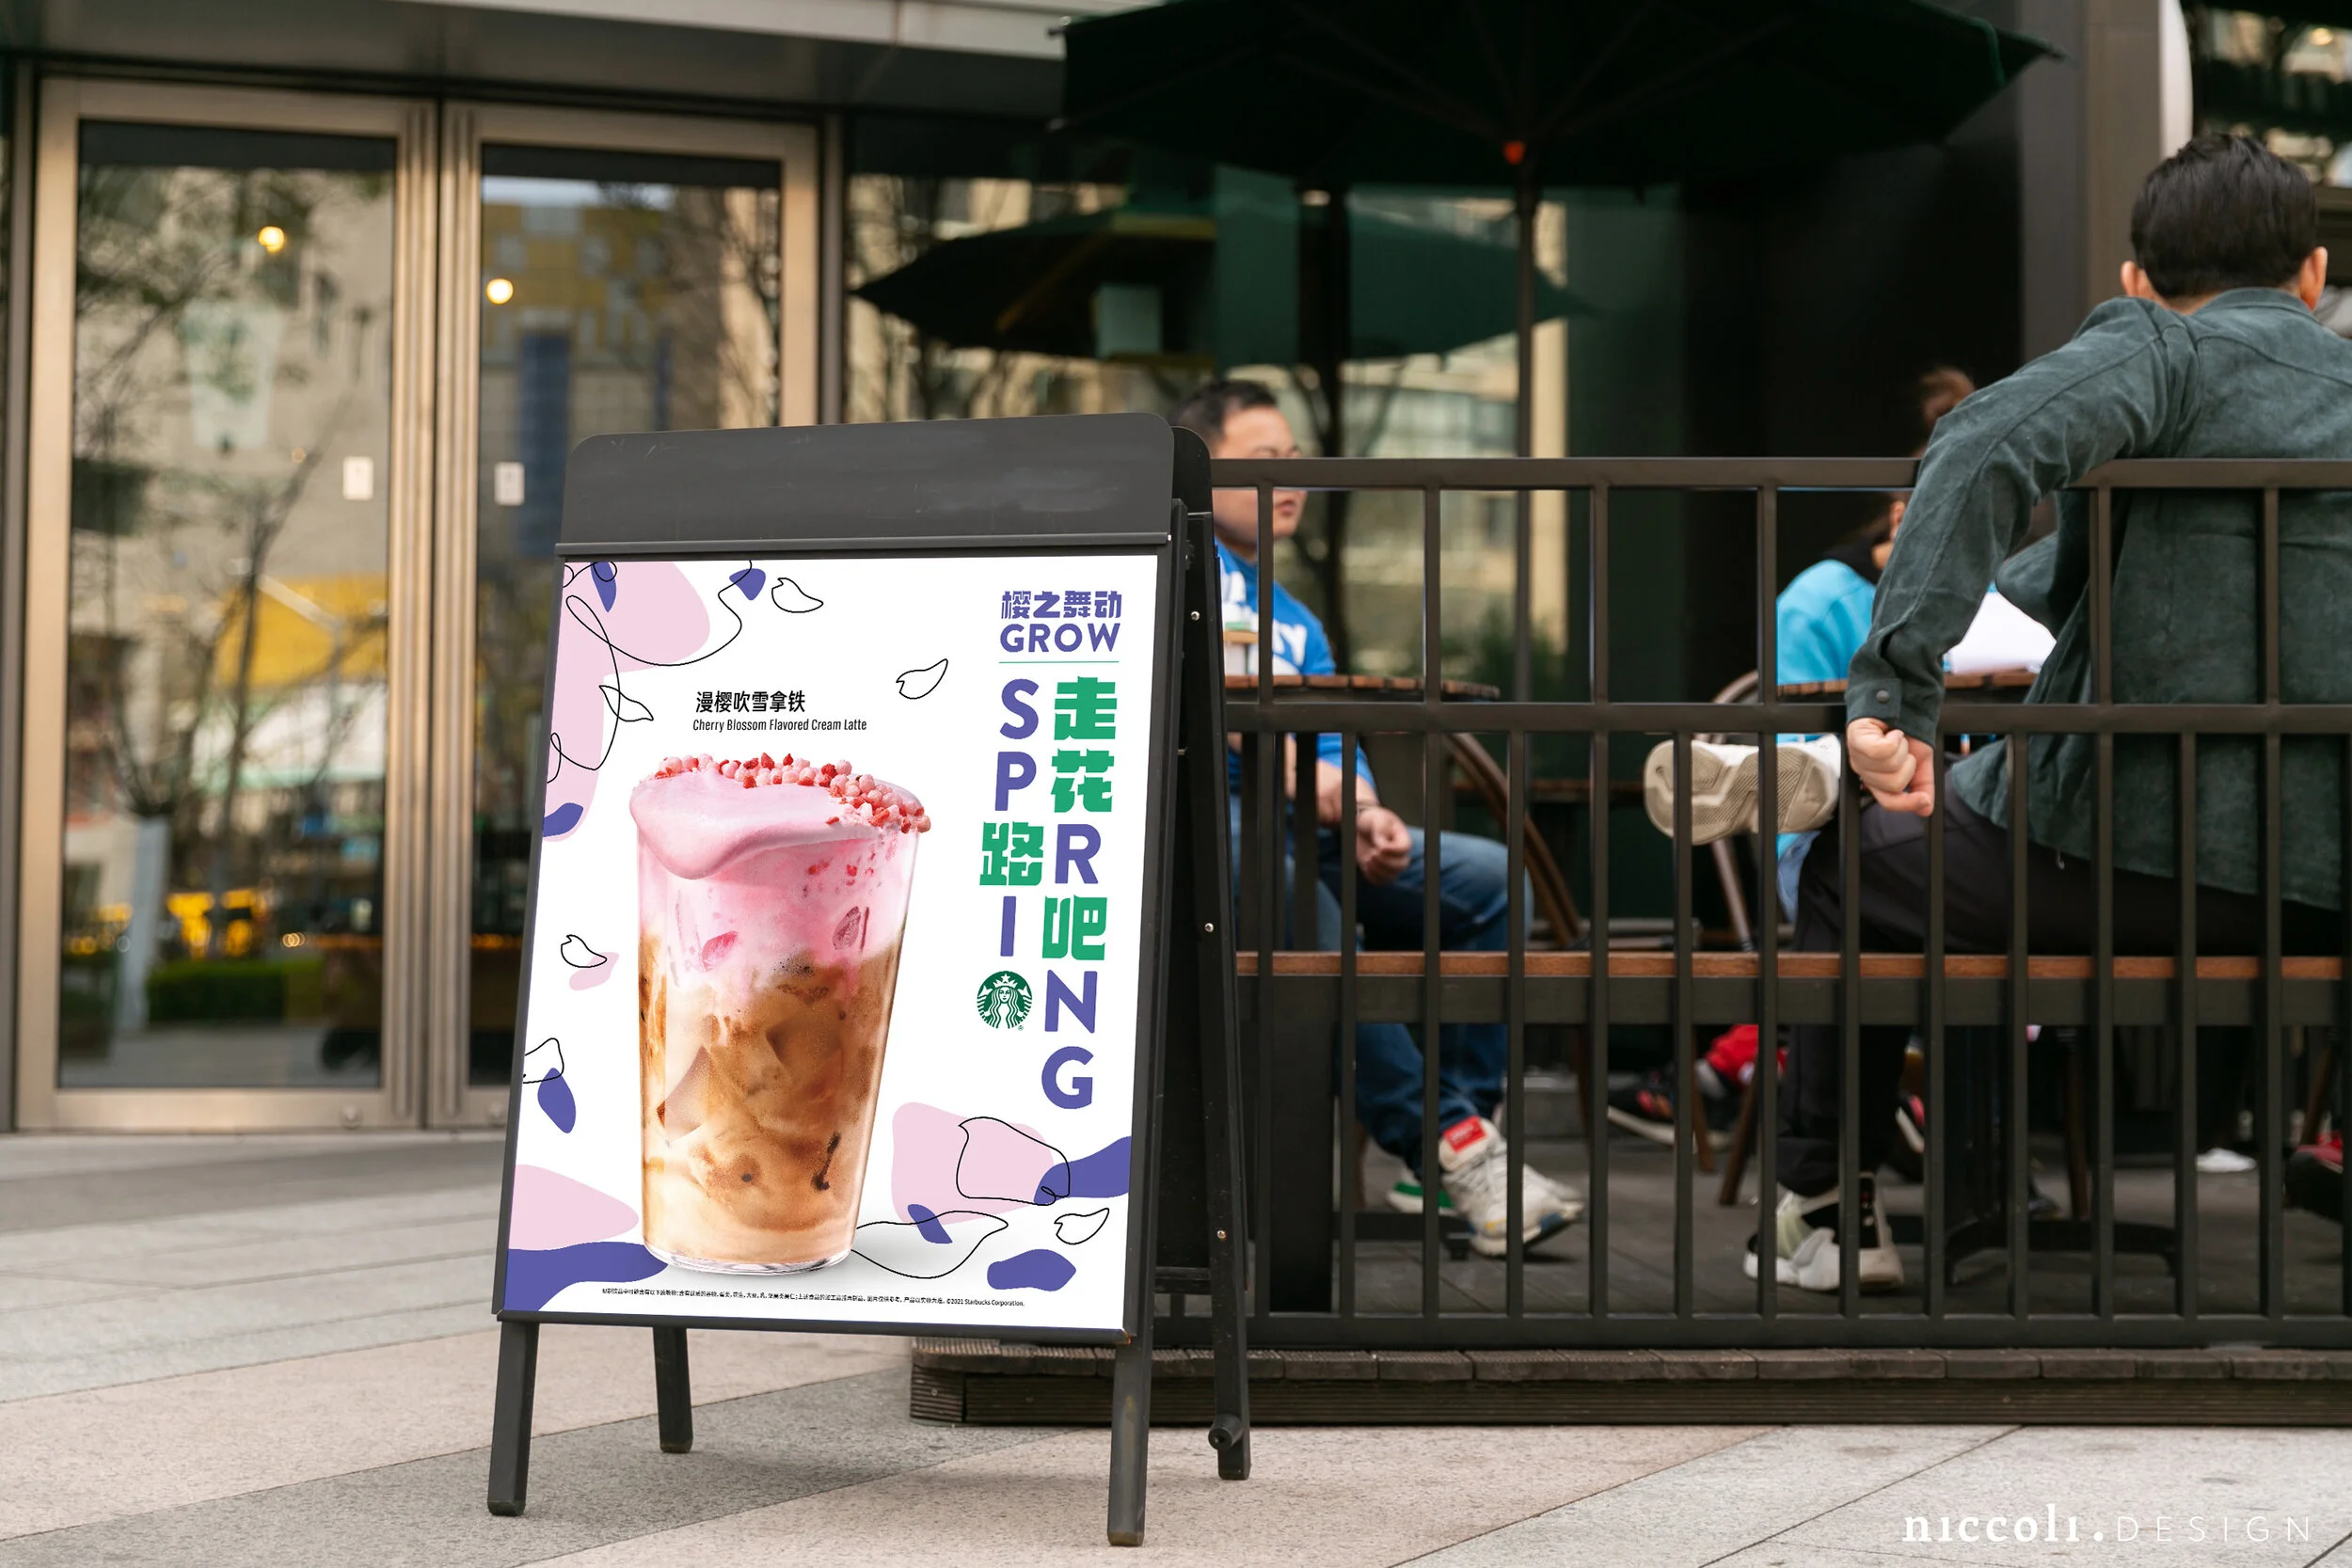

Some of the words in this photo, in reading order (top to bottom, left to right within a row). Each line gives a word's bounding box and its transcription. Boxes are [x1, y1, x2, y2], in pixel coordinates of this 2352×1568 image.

[1001, 591, 1121, 619] 樱之舞动
[1000, 622, 1121, 653] GROW
[695, 690, 806, 713] 漫樱吹雪拿铁
[692, 719, 724, 733] Cherry
[727, 719, 767, 731] Blossom
[770, 719, 809, 731] Flavored
[811, 720, 842, 731] Cream
[844, 720, 867, 731] Latte
